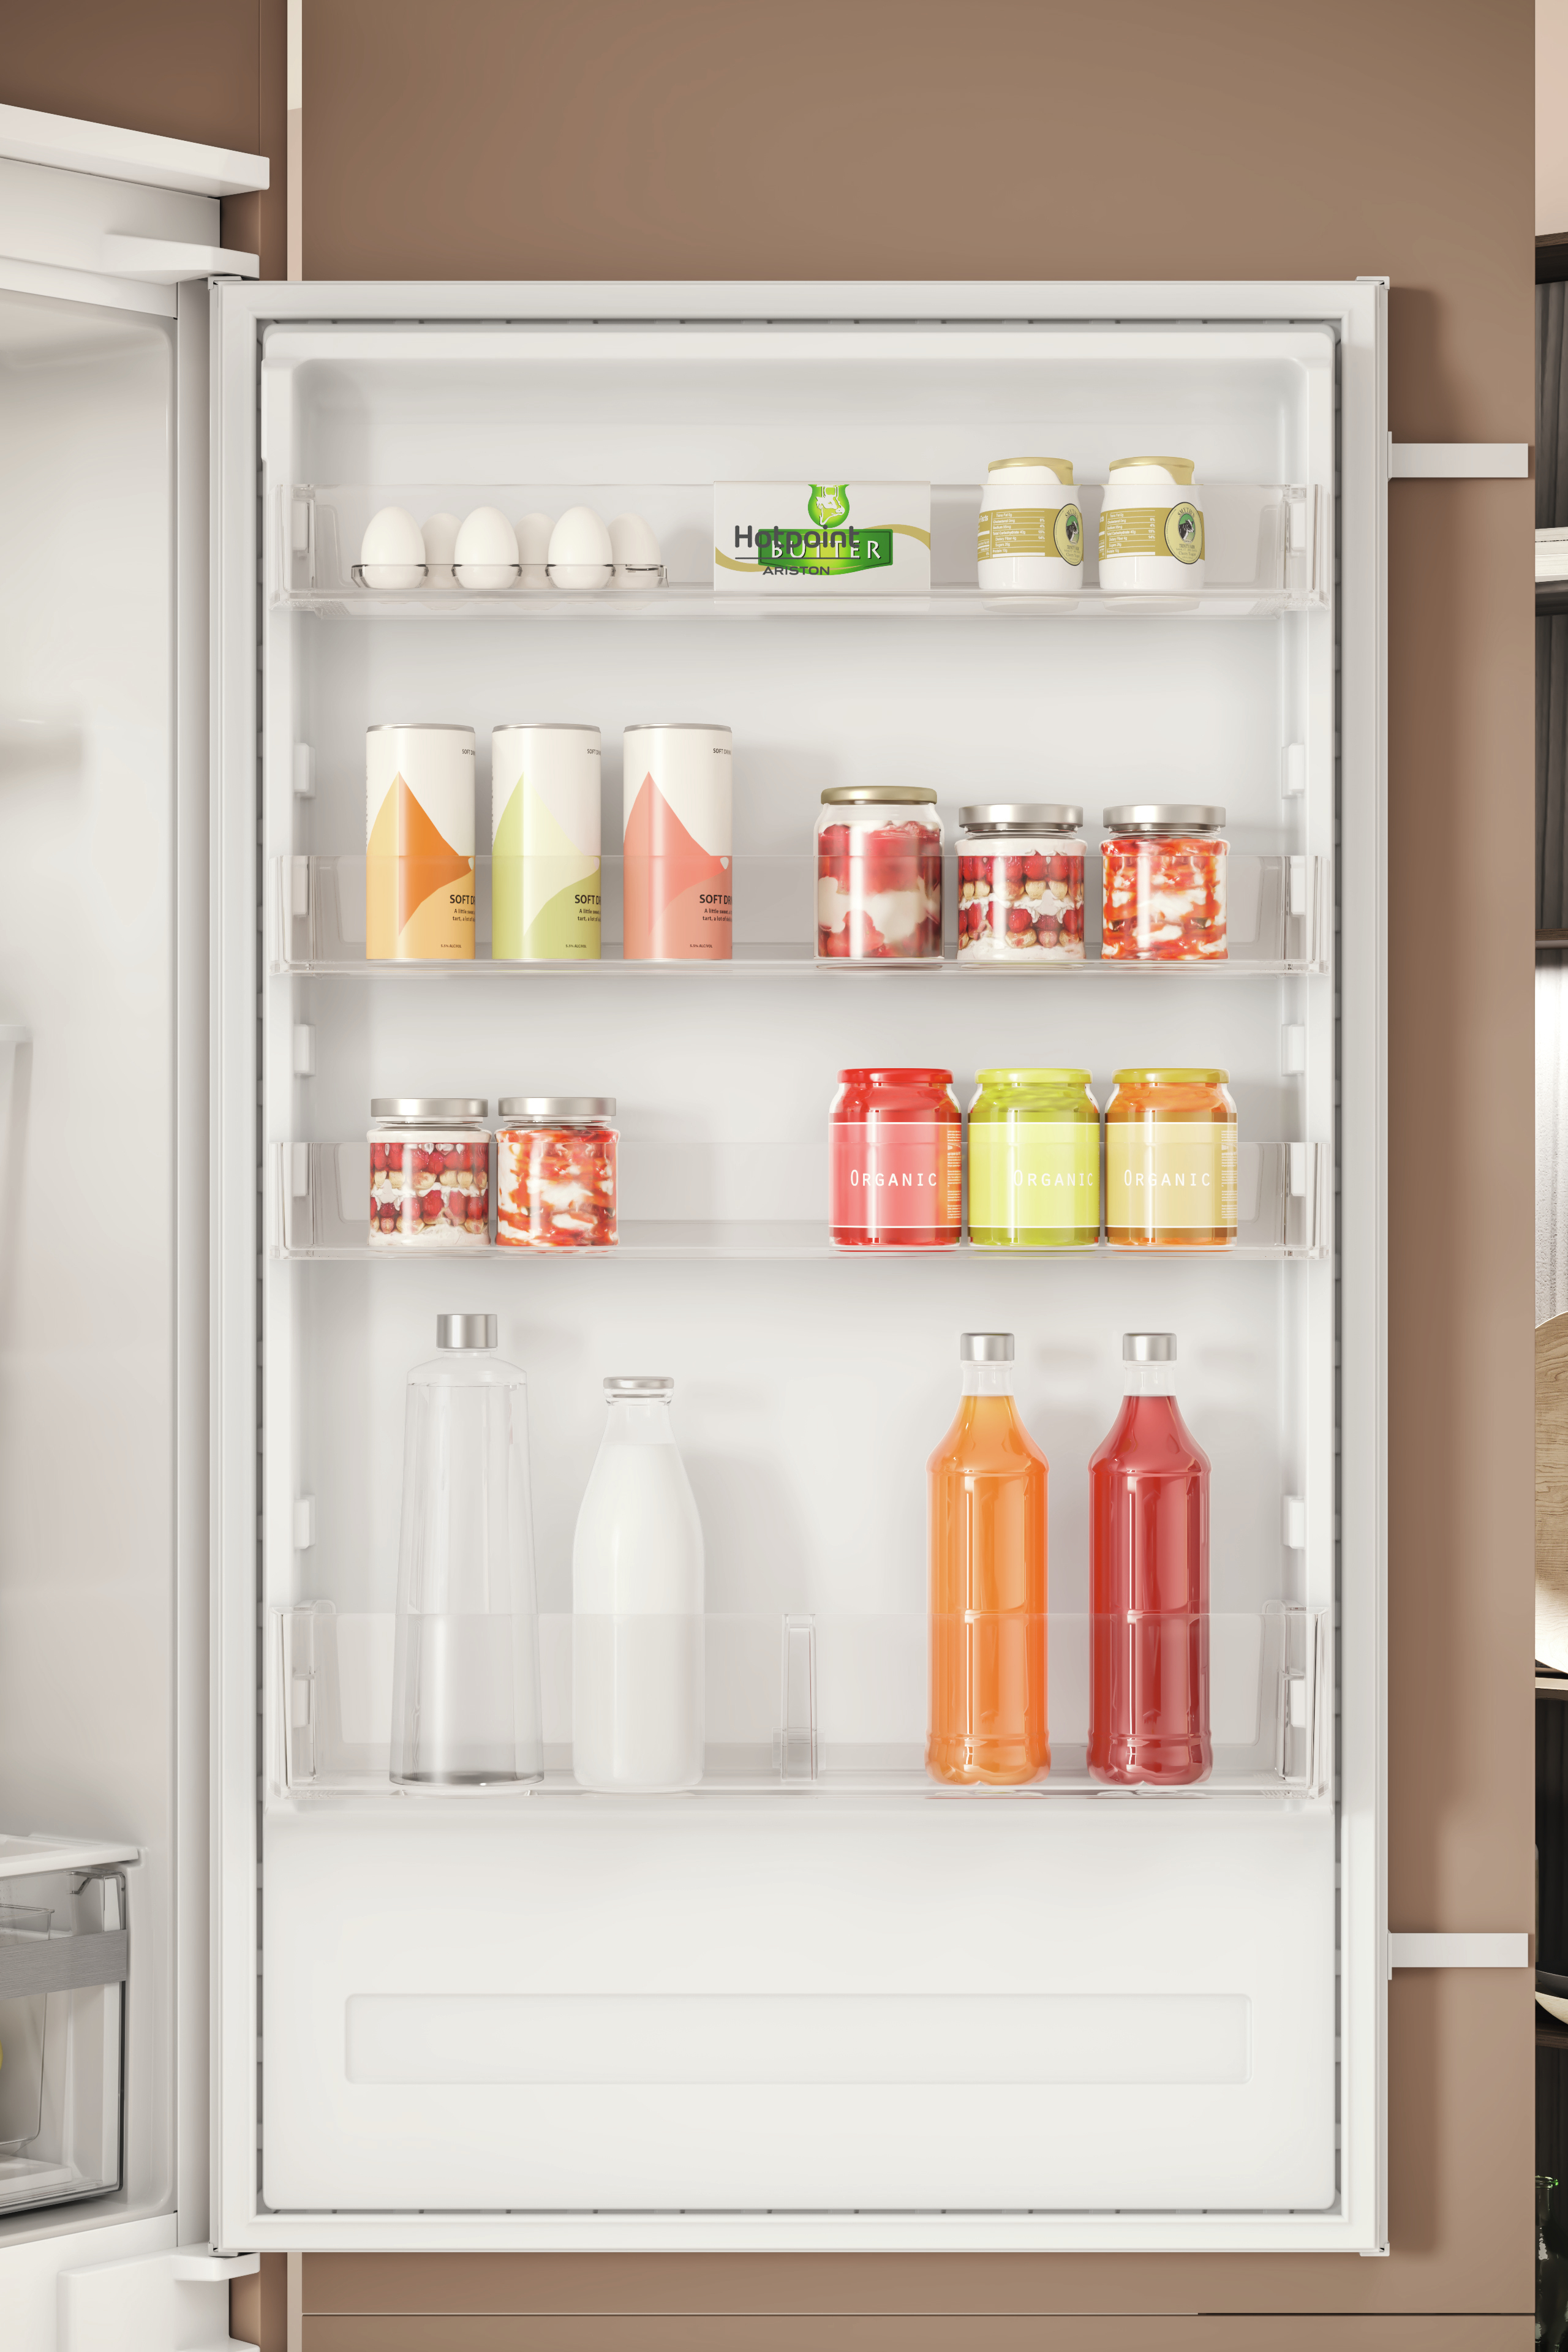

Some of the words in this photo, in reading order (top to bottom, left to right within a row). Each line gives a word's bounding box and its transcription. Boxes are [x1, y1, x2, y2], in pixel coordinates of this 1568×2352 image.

[1178, 508, 1194, 518] SMYTH'S
[735, 525, 859, 554] Hotpoint
[772, 540, 881, 559] BUTTER
[763, 566, 830, 575] ARISTON
[450, 895, 469, 904] SOFT
[575, 895, 595, 904] SOFT
[699, 894, 722, 904] SOFT
[850, 1169, 937, 1186] ORGANIC
[1014, 1169, 1093, 1186] ORGANIC
[1124, 1169, 1210, 1186] ORGANIC
